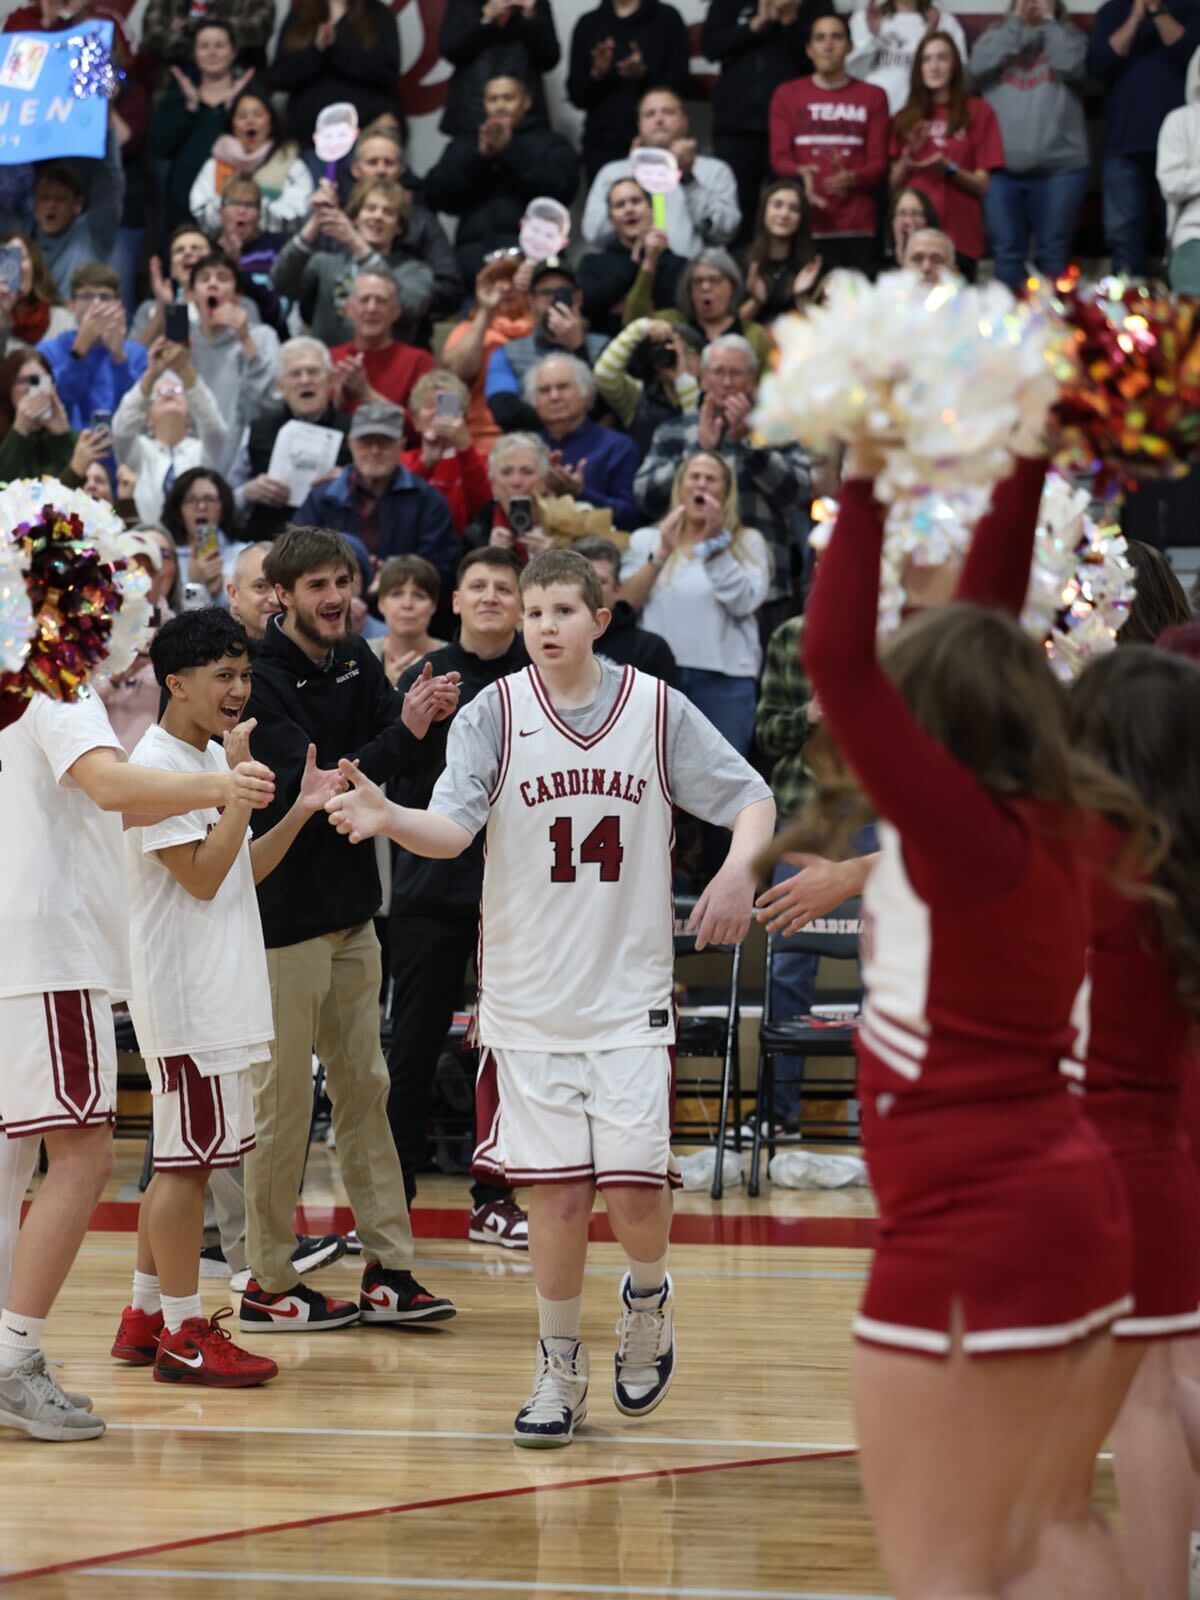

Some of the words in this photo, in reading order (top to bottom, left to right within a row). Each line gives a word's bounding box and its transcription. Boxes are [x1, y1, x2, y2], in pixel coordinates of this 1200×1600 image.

[807, 102, 867, 123] TEAM
[519, 768, 648, 808] CARDINALS
[549, 815, 624, 883] 14
[797, 917, 864, 935] ARDIN
